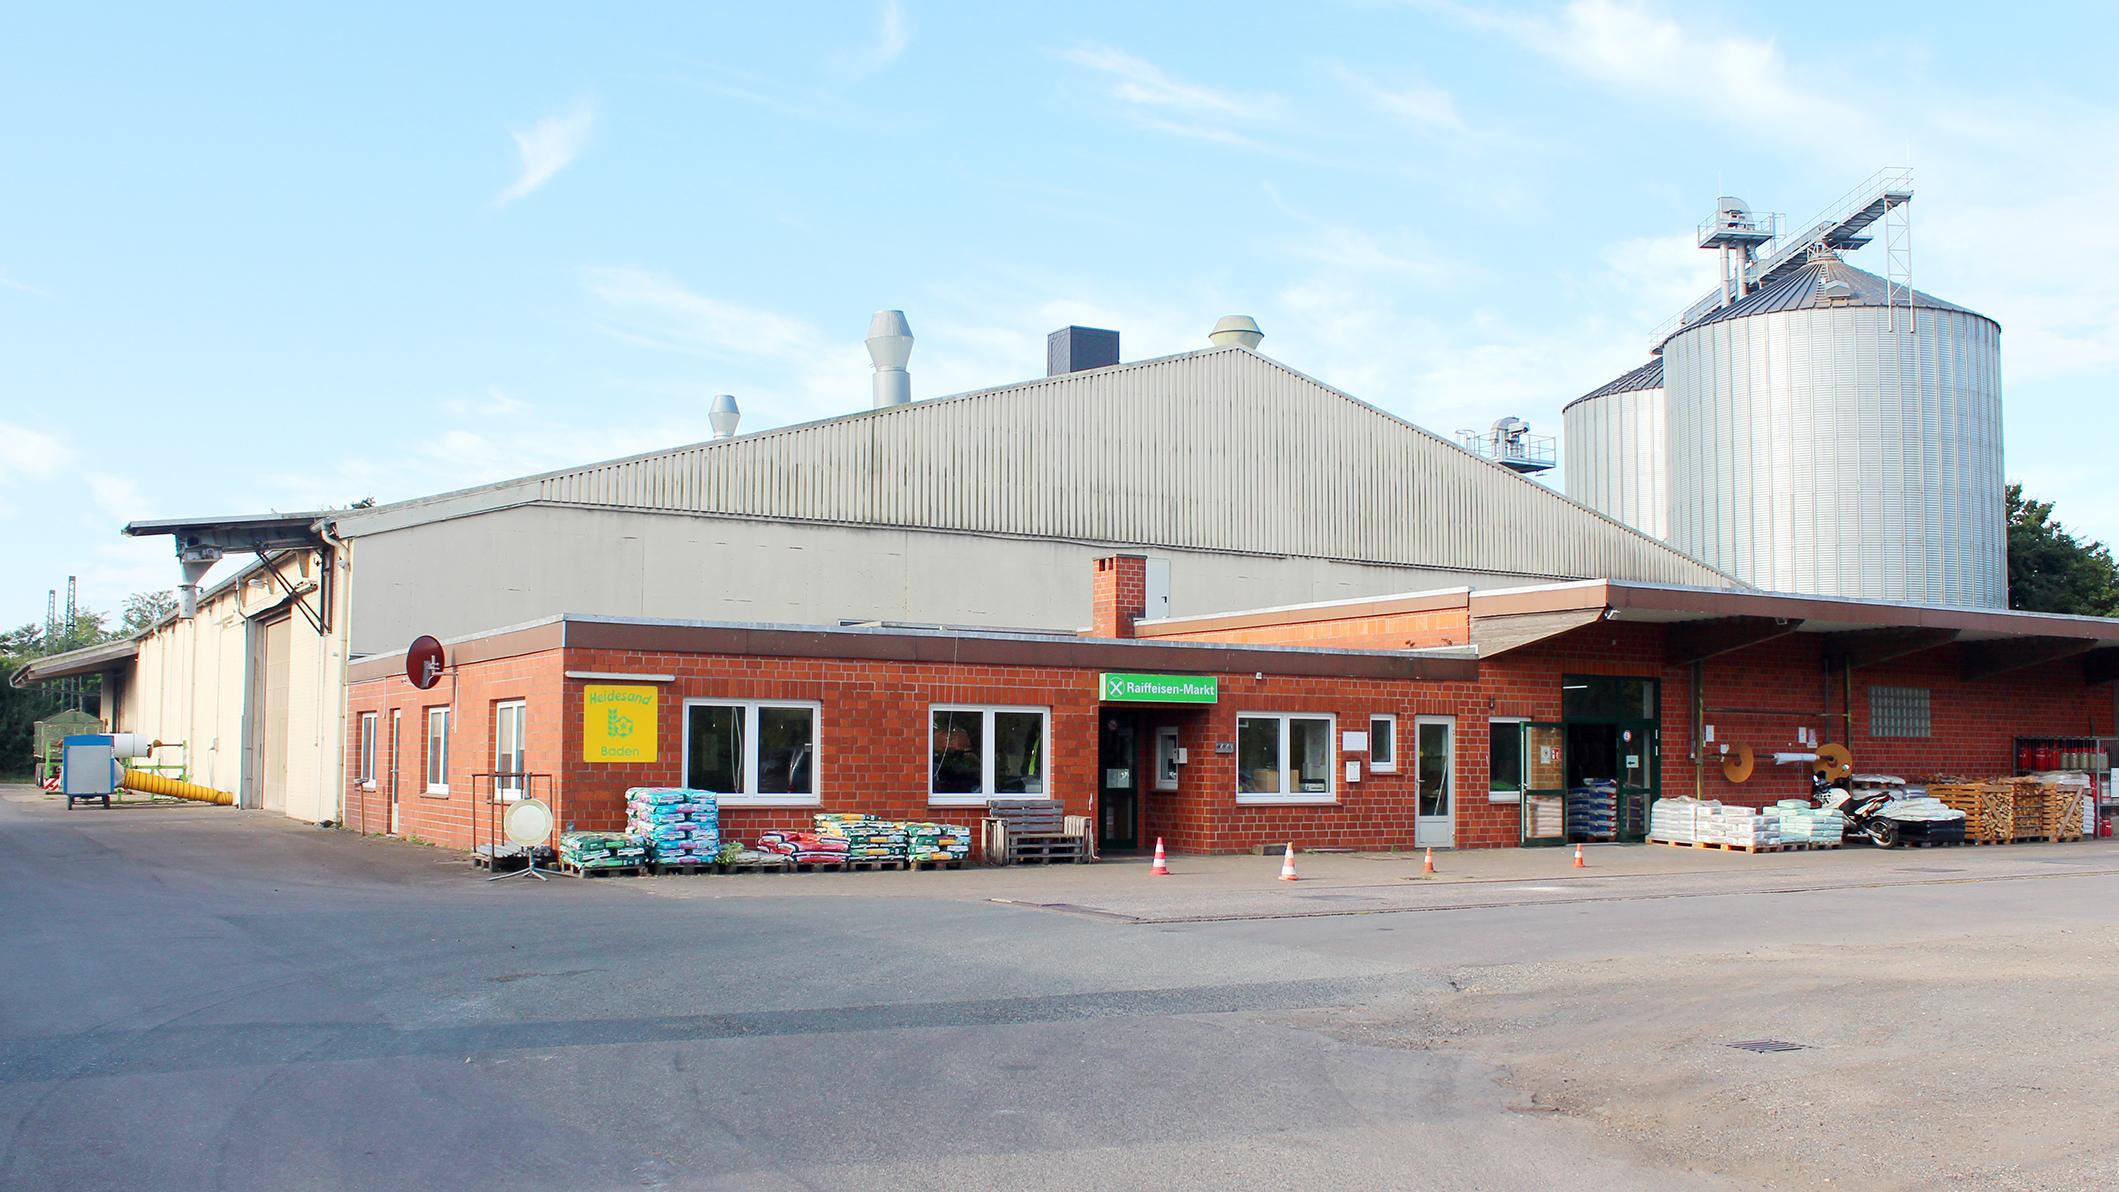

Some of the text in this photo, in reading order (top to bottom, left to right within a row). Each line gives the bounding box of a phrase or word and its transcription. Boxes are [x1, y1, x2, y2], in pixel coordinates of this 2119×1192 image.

[1126, 681, 1215, 696] Raiffeisen-Markt
[590, 690, 653, 705] Heidesand
[601, 745, 640, 757] Baden
